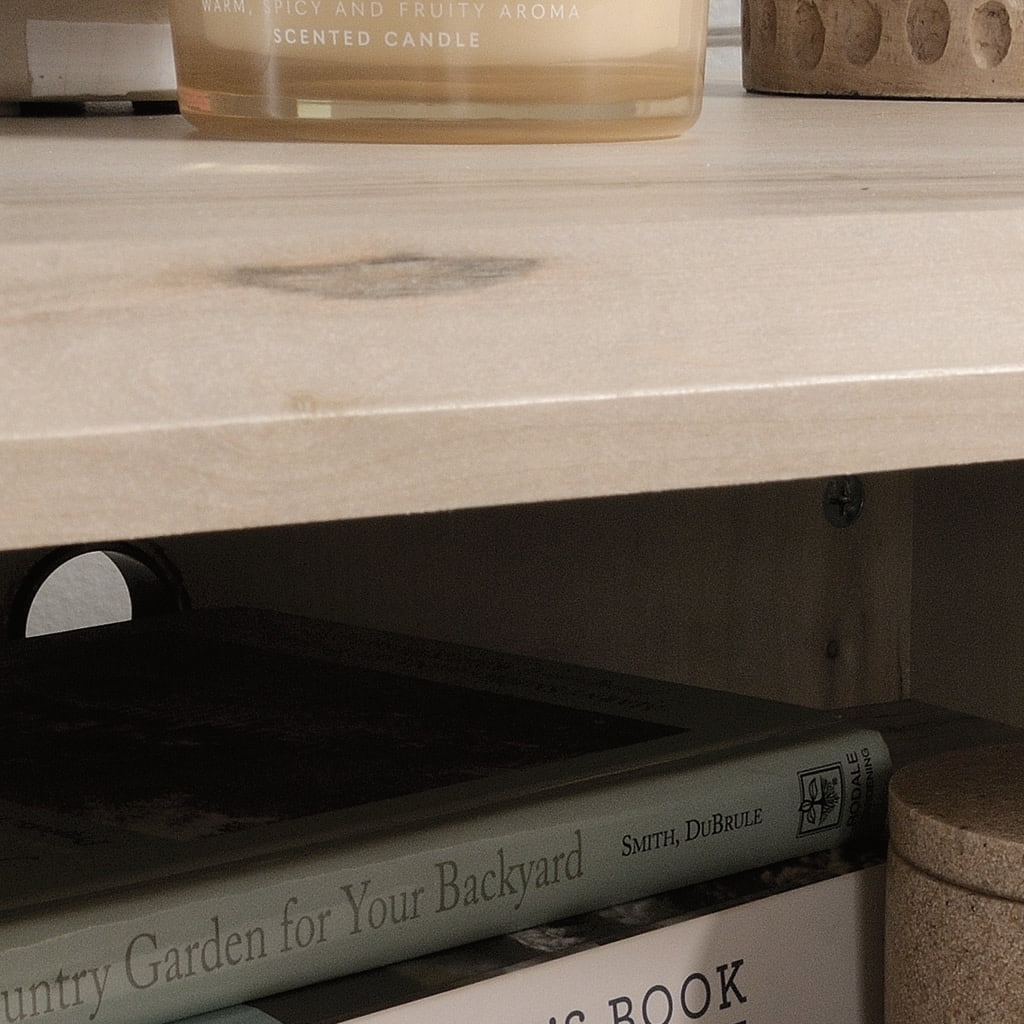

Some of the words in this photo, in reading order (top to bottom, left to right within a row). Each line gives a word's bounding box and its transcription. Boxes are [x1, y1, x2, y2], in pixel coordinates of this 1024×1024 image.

[202, 0, 253, 16] WARM,
[263, 0, 321, 16] SPICY
[335, 1, 383, 17] AND
[400, 2, 485, 18] FRUITY
[500, 3, 580, 19] AROMA
[273, 28, 370, 46] SCENTED
[384, 31, 480, 48] CANDLE
[621, 828, 680, 857] SMITH,
[125, 915, 268, 990] Garden
[280, 897, 332, 953] for
[340, 879, 425, 936] Your
[435, 829, 584, 914] Backyard
